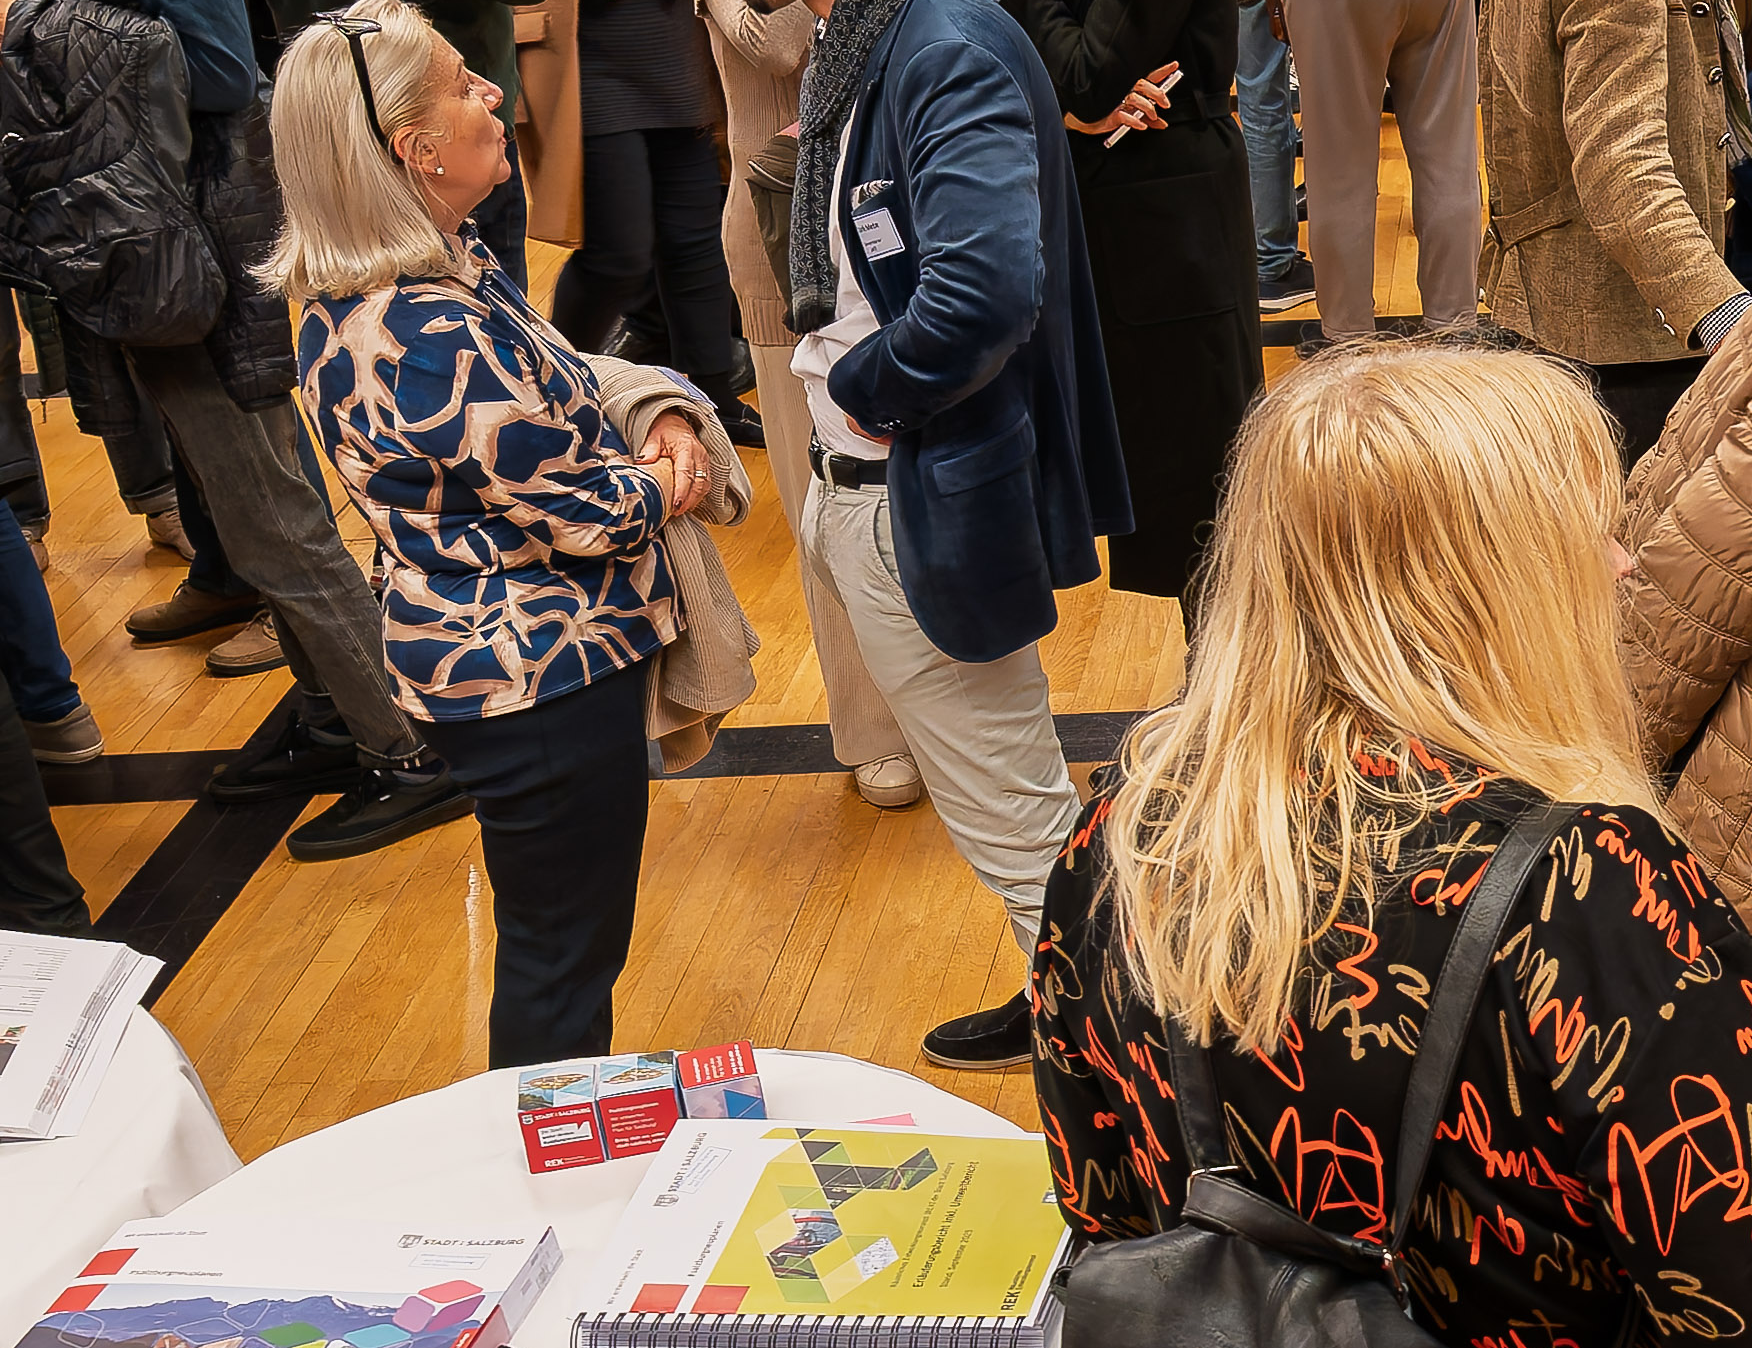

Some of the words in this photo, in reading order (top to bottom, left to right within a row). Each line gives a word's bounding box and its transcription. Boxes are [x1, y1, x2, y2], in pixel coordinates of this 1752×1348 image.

[534, 1112, 554, 1121] STADT
[558, 1105, 591, 1118] SALZBURG
[544, 1158, 564, 1168] REK
[667, 1172, 687, 1192] STADT
[681, 1133, 708, 1165] SALZBURG
[912, 1225, 955, 1287] Erläuterungsbericht
[947, 1162, 982, 1207] Umweltbericht
[422, 1238, 457, 1247] STADT
[466, 1237, 525, 1247] SALZBURG
[998, 1292, 1022, 1310] REK
